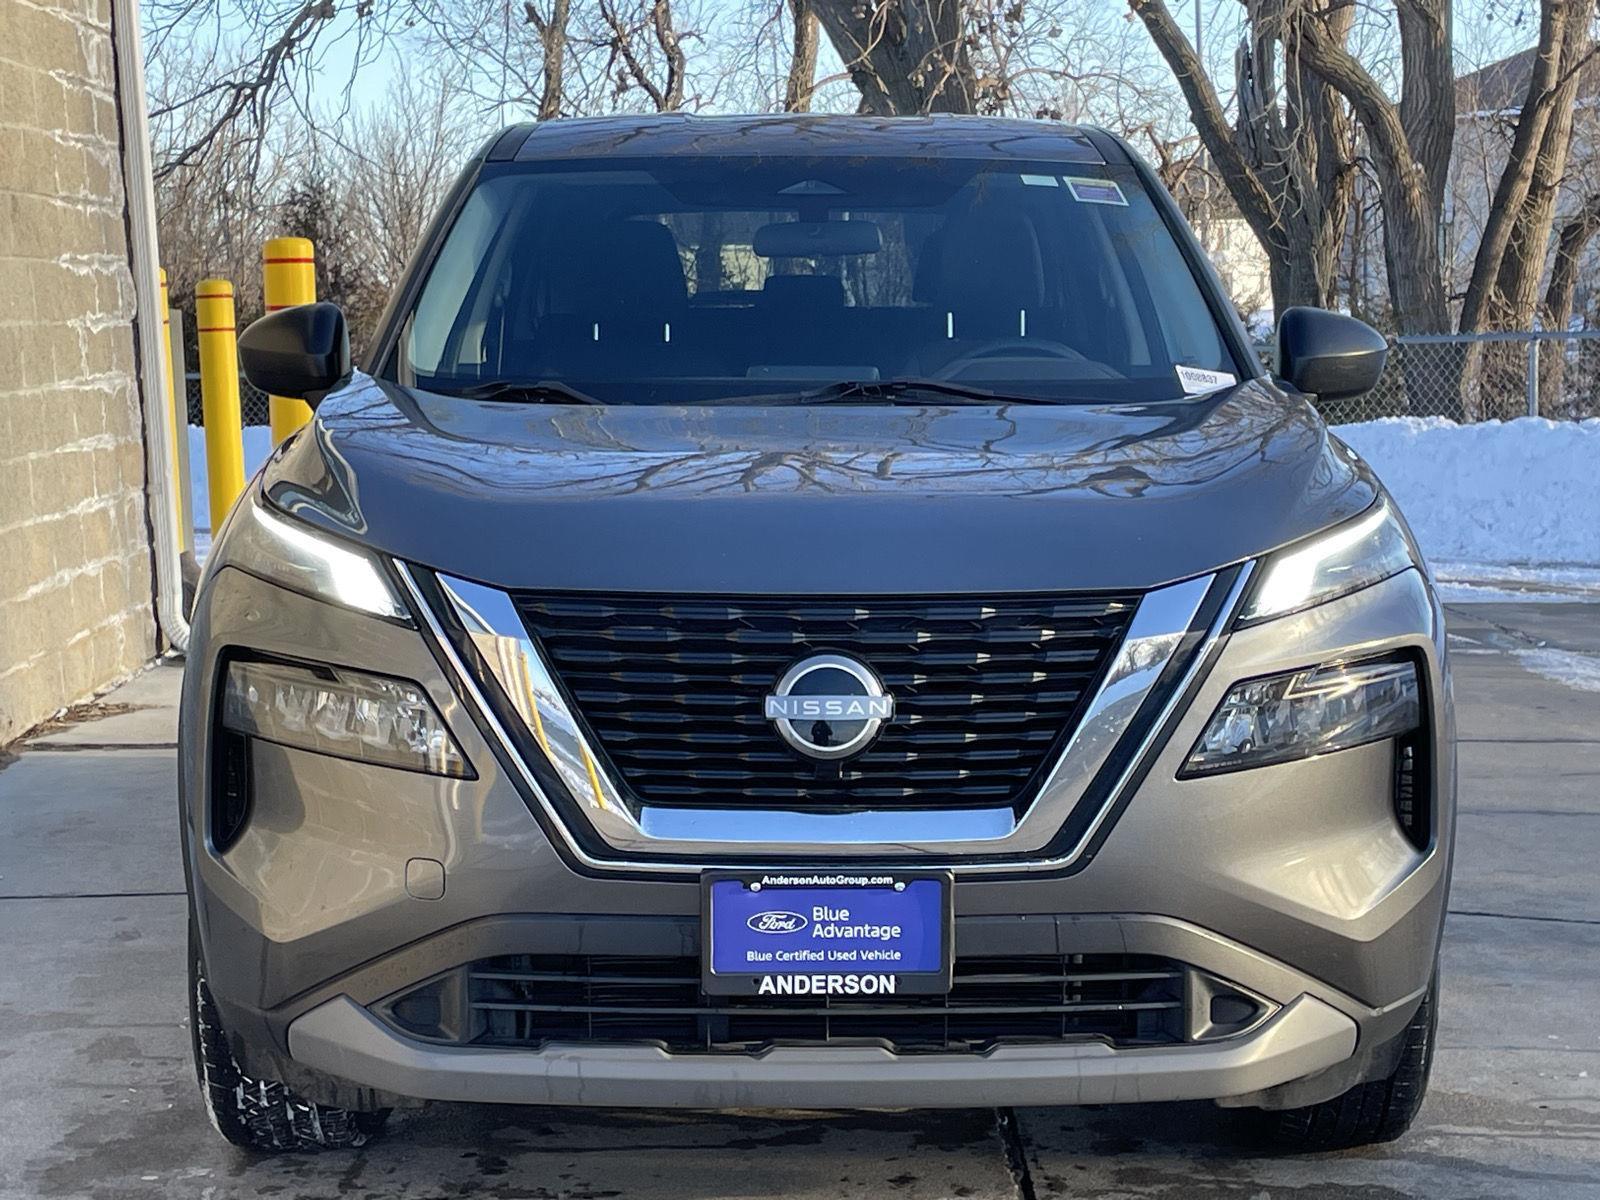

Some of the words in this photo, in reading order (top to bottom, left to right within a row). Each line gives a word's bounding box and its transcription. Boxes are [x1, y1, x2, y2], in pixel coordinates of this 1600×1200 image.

[770, 700, 887, 715] NISSAN
[762, 875, 893, 886] AndersonAutoGroup.com
[812, 906, 849, 921] Blue
[758, 914, 796, 930] Ford
[812, 923, 901, 940] Advantage
[747, 951, 772, 961] Blue
[775, 950, 824, 961] Certified
[827, 950, 857, 961] Used
[860, 950, 901, 961] Vehicle
[758, 975, 896, 995] ANDERSON
